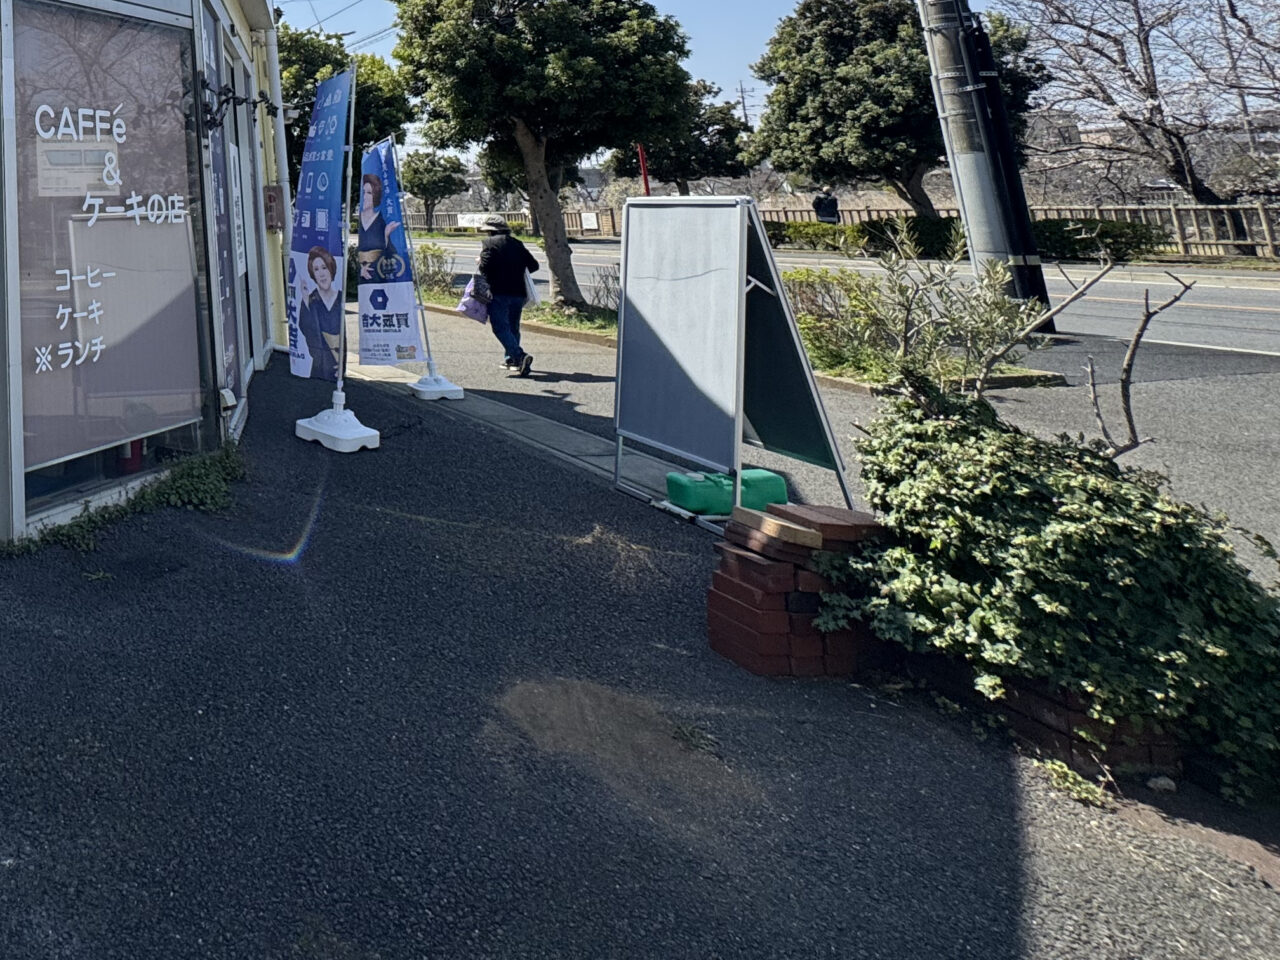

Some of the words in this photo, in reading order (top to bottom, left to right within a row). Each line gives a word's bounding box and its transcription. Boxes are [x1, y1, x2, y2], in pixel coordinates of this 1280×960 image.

[102, 151, 123, 186] &
[82, 191, 186, 227] ケーキの店
[55, 265, 117, 291] コーヒー
[55, 299, 105, 330] ケーキ
